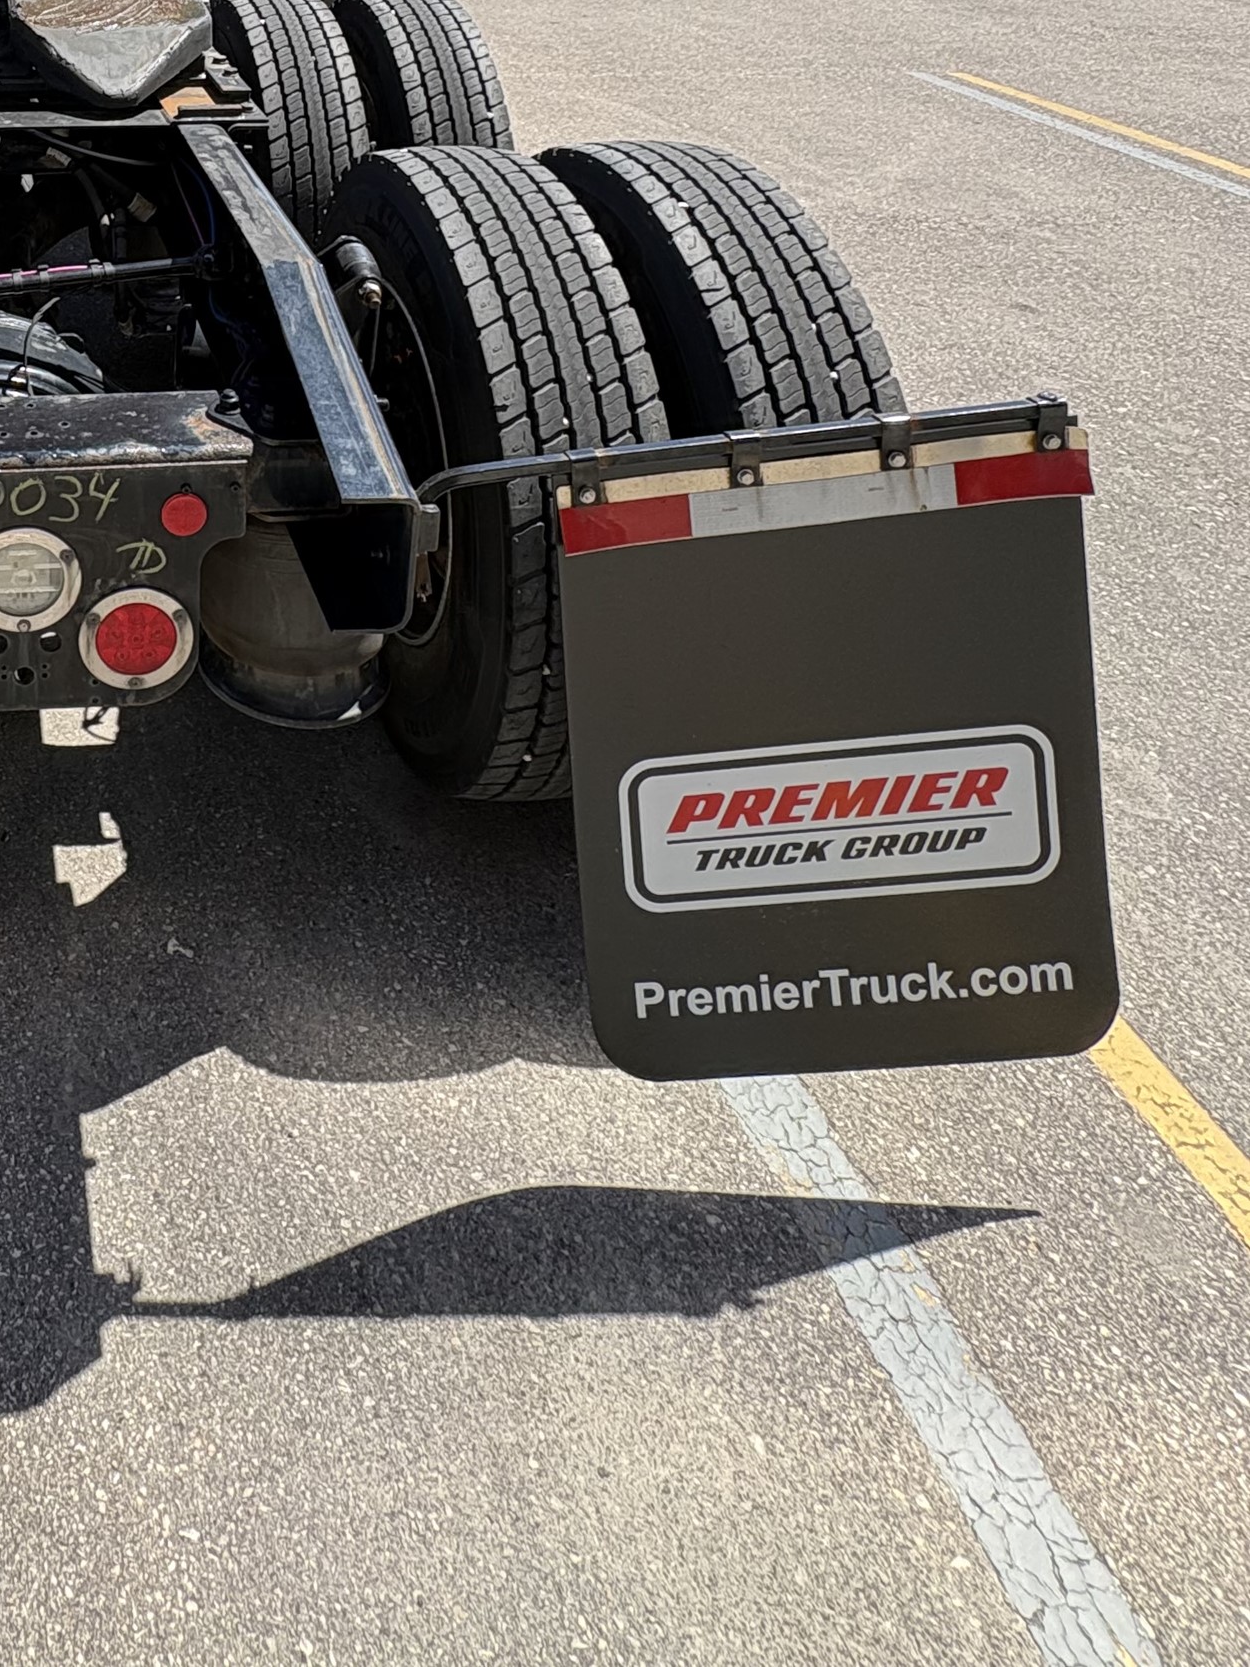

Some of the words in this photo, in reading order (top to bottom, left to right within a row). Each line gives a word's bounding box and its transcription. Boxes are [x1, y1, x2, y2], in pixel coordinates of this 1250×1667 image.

[666, 766, 1009, 834] PREMIER
[694, 839, 835, 872] TRUCK
[841, 827, 987, 861] GROUP
[634, 960, 1074, 1019] PremierTruck.com
